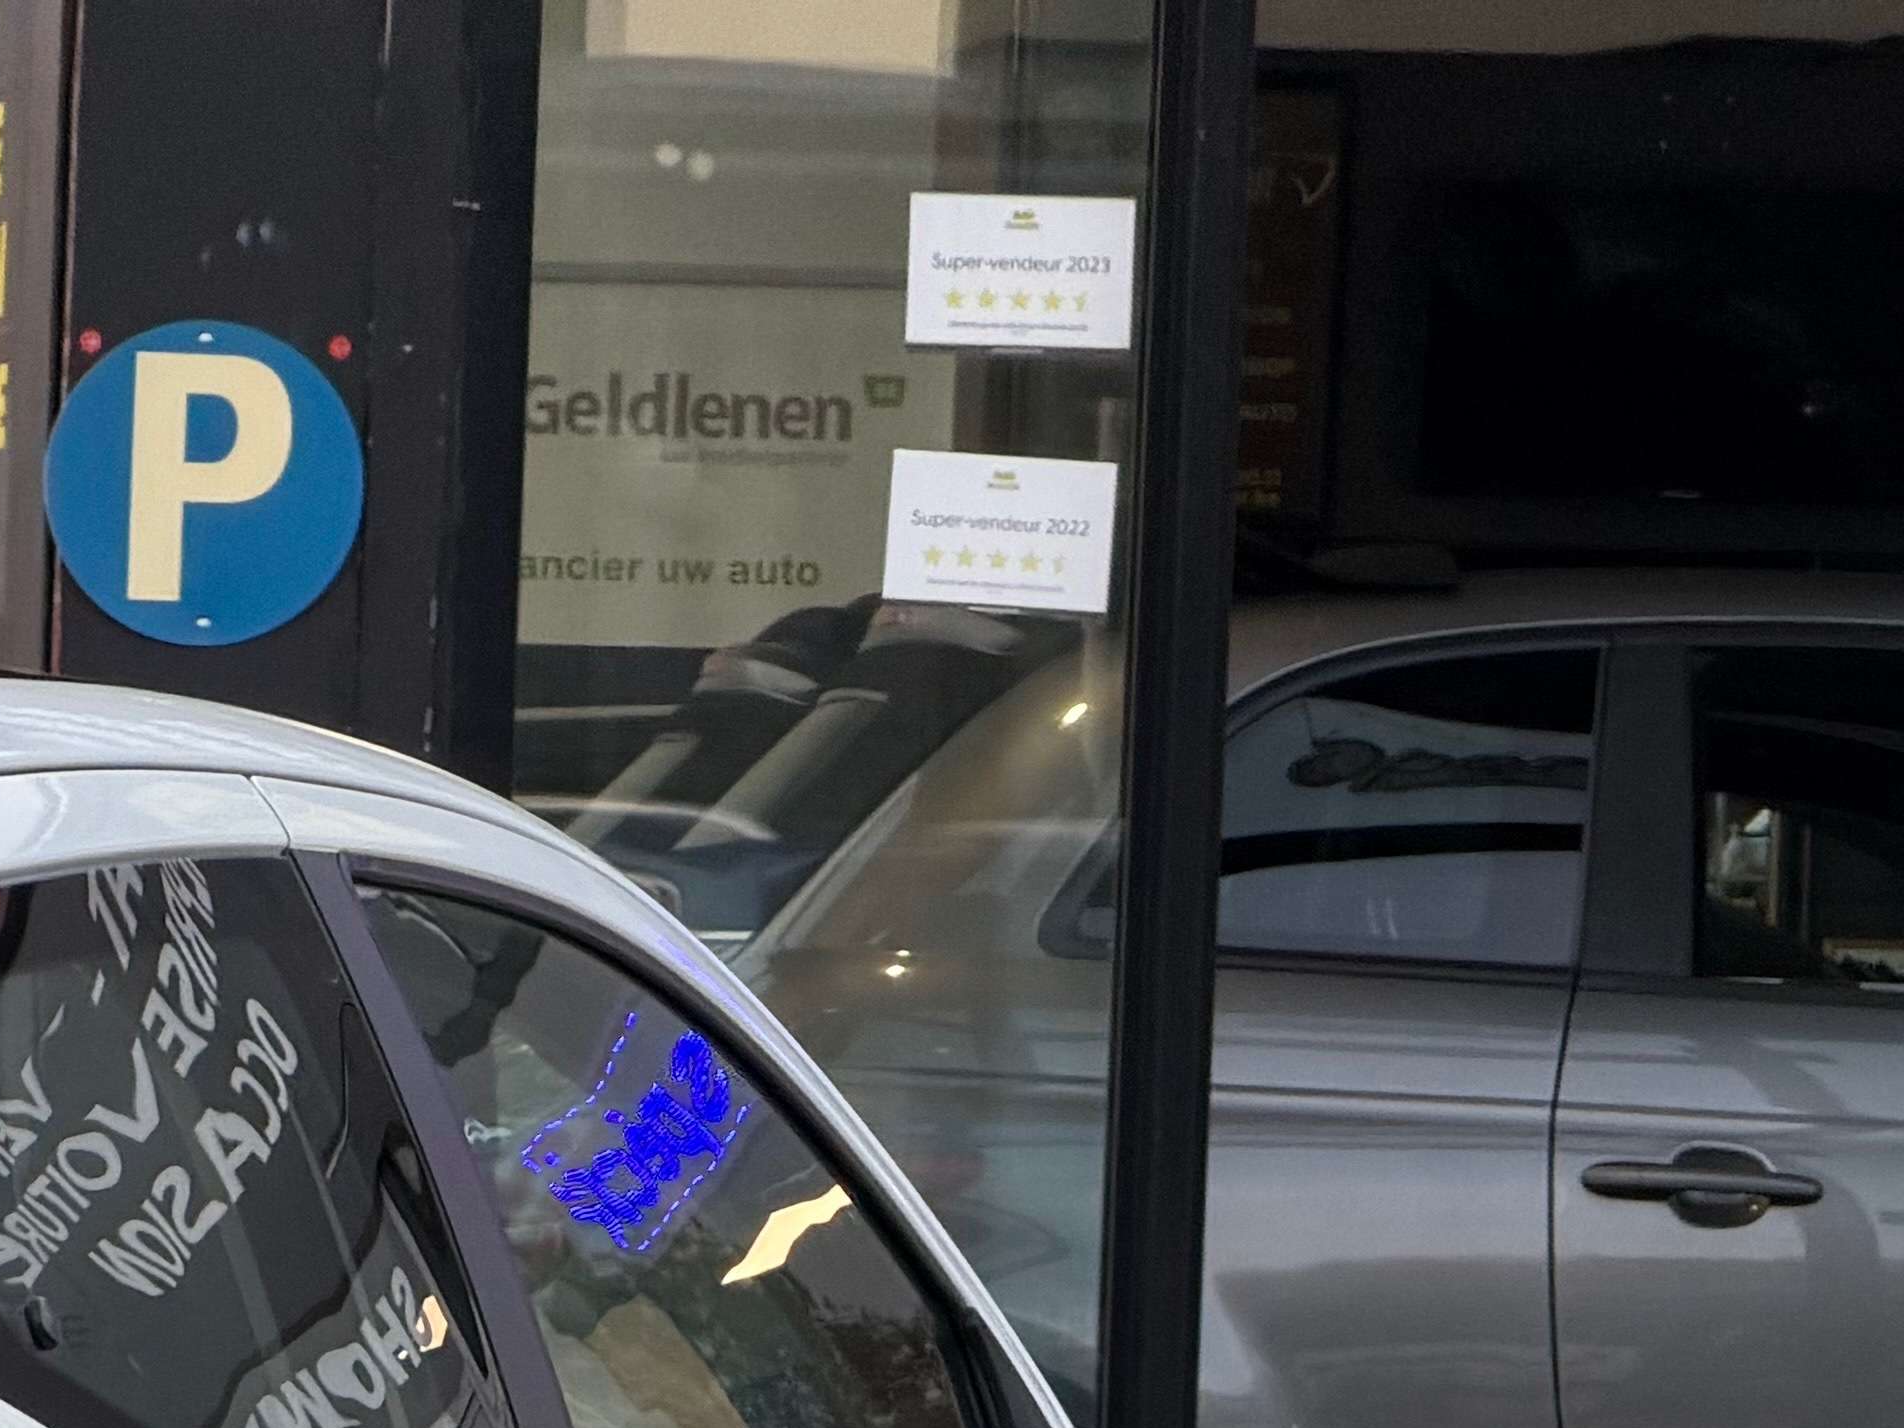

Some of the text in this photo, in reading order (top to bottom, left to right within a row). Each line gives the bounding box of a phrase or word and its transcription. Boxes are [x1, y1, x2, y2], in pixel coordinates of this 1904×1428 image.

[931, 252, 1111, 274] Super-vendeur 2023
[126, 351, 293, 601] P
[910, 509, 1091, 537] Super-vendeur 2022
[519, 550, 821, 587] ancier uw auto
